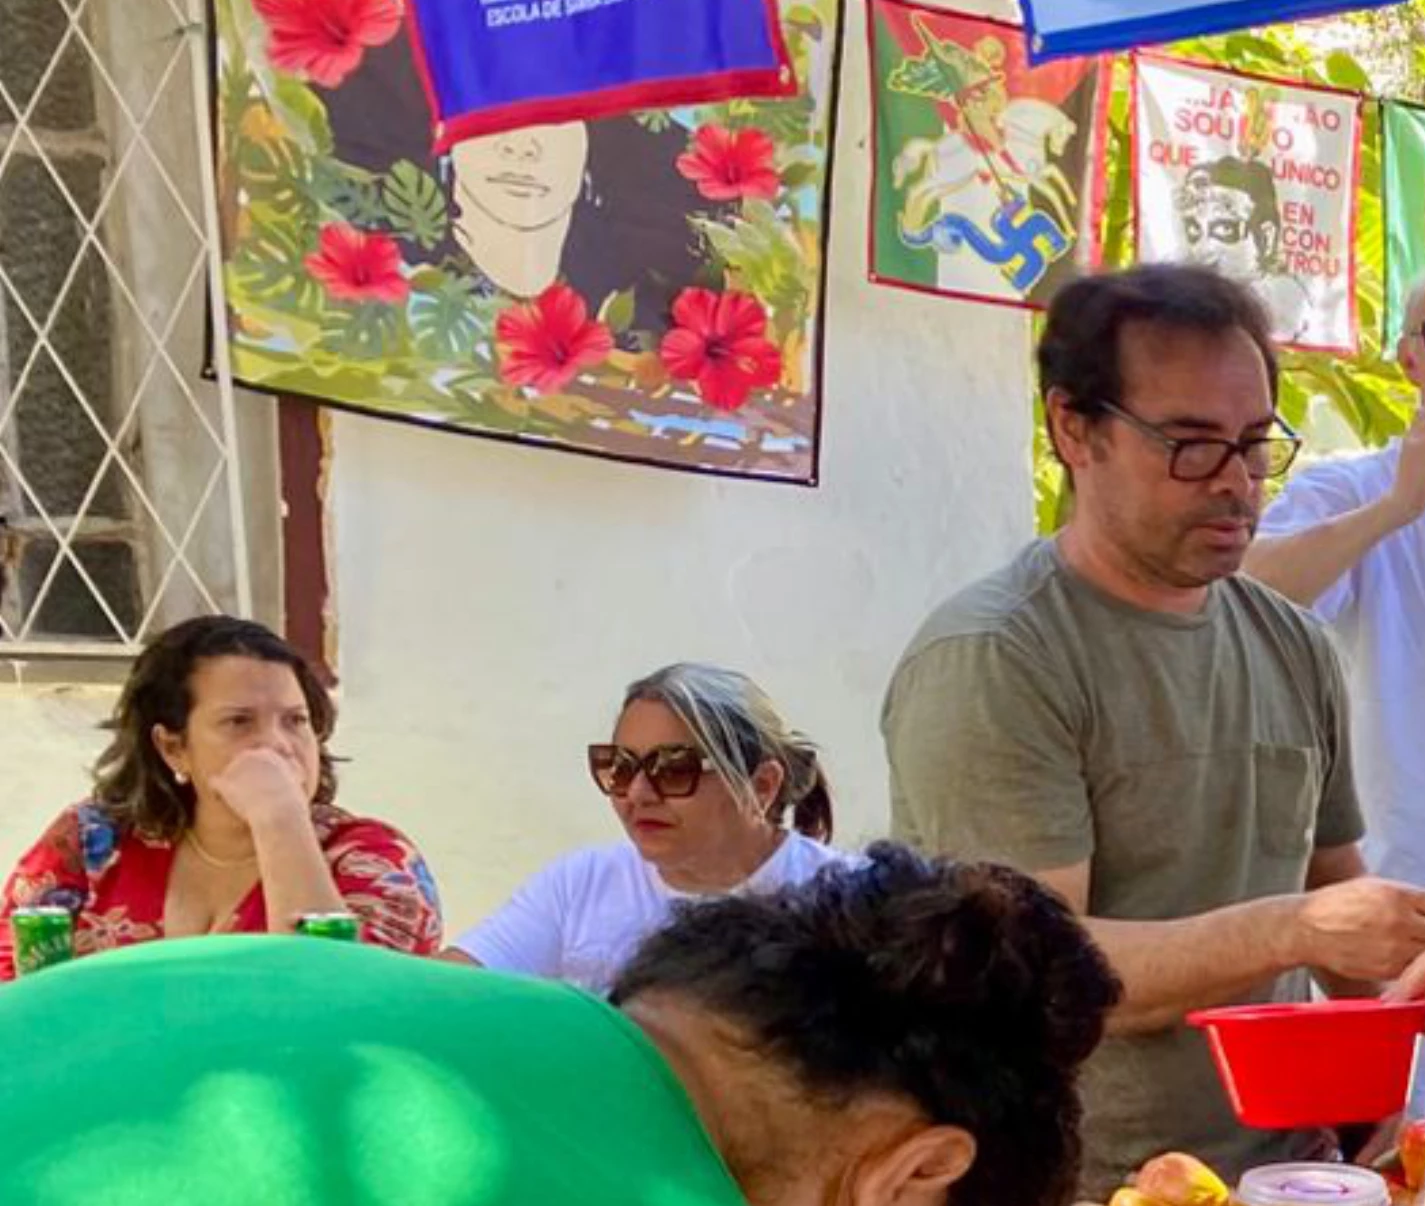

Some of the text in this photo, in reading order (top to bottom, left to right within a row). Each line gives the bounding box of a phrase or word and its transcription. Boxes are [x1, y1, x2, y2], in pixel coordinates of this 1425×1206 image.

[486, 6, 541, 27] ESCOLA
[1174, 107, 1234, 141] SOU
[1149, 139, 1198, 168] QUE
[1282, 202, 1315, 226] EN
[1282, 228, 1331, 252] CON
[1283, 250, 1341, 278] TROU
